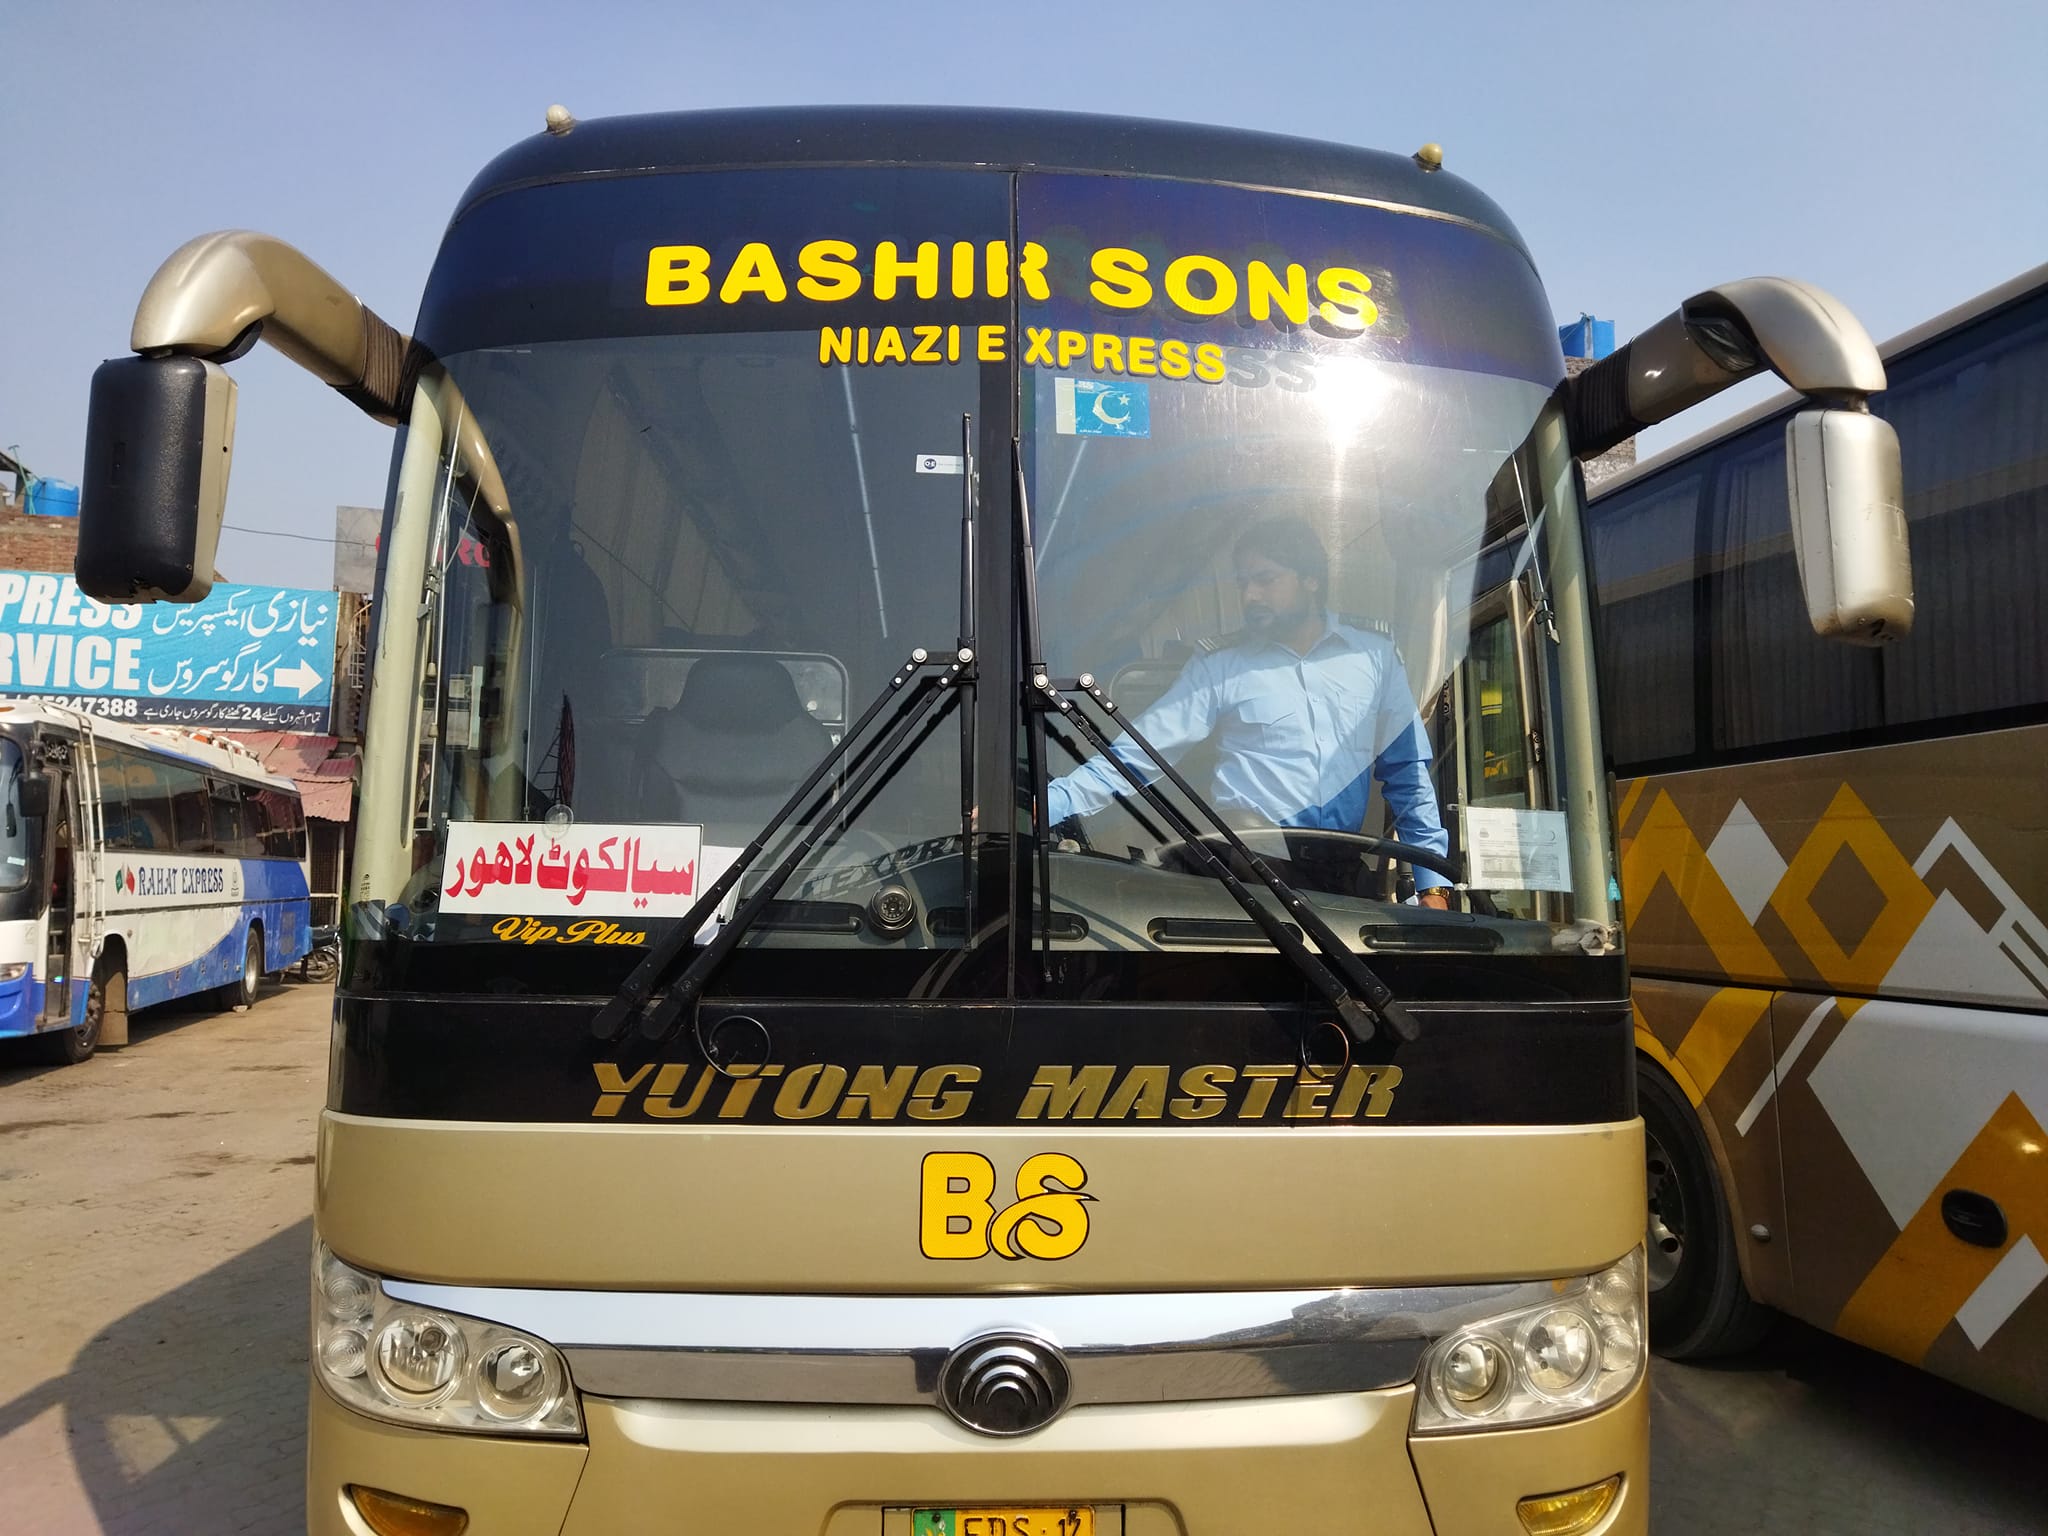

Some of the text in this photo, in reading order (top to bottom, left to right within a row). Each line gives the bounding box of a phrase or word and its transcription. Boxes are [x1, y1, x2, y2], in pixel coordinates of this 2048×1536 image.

[645, 240, 1380, 330] BASHIR SONS
[818, 324, 962, 365] NIAZI
[247, 590, 329, 647] نیازی
[241, 706, 262, 720] 24
[138, 866, 224, 896] RAHAT EXPRESS
[492, 916, 646, 946] Vip Plus
[591, 1062, 1404, 1121] YUTONG MASTER
